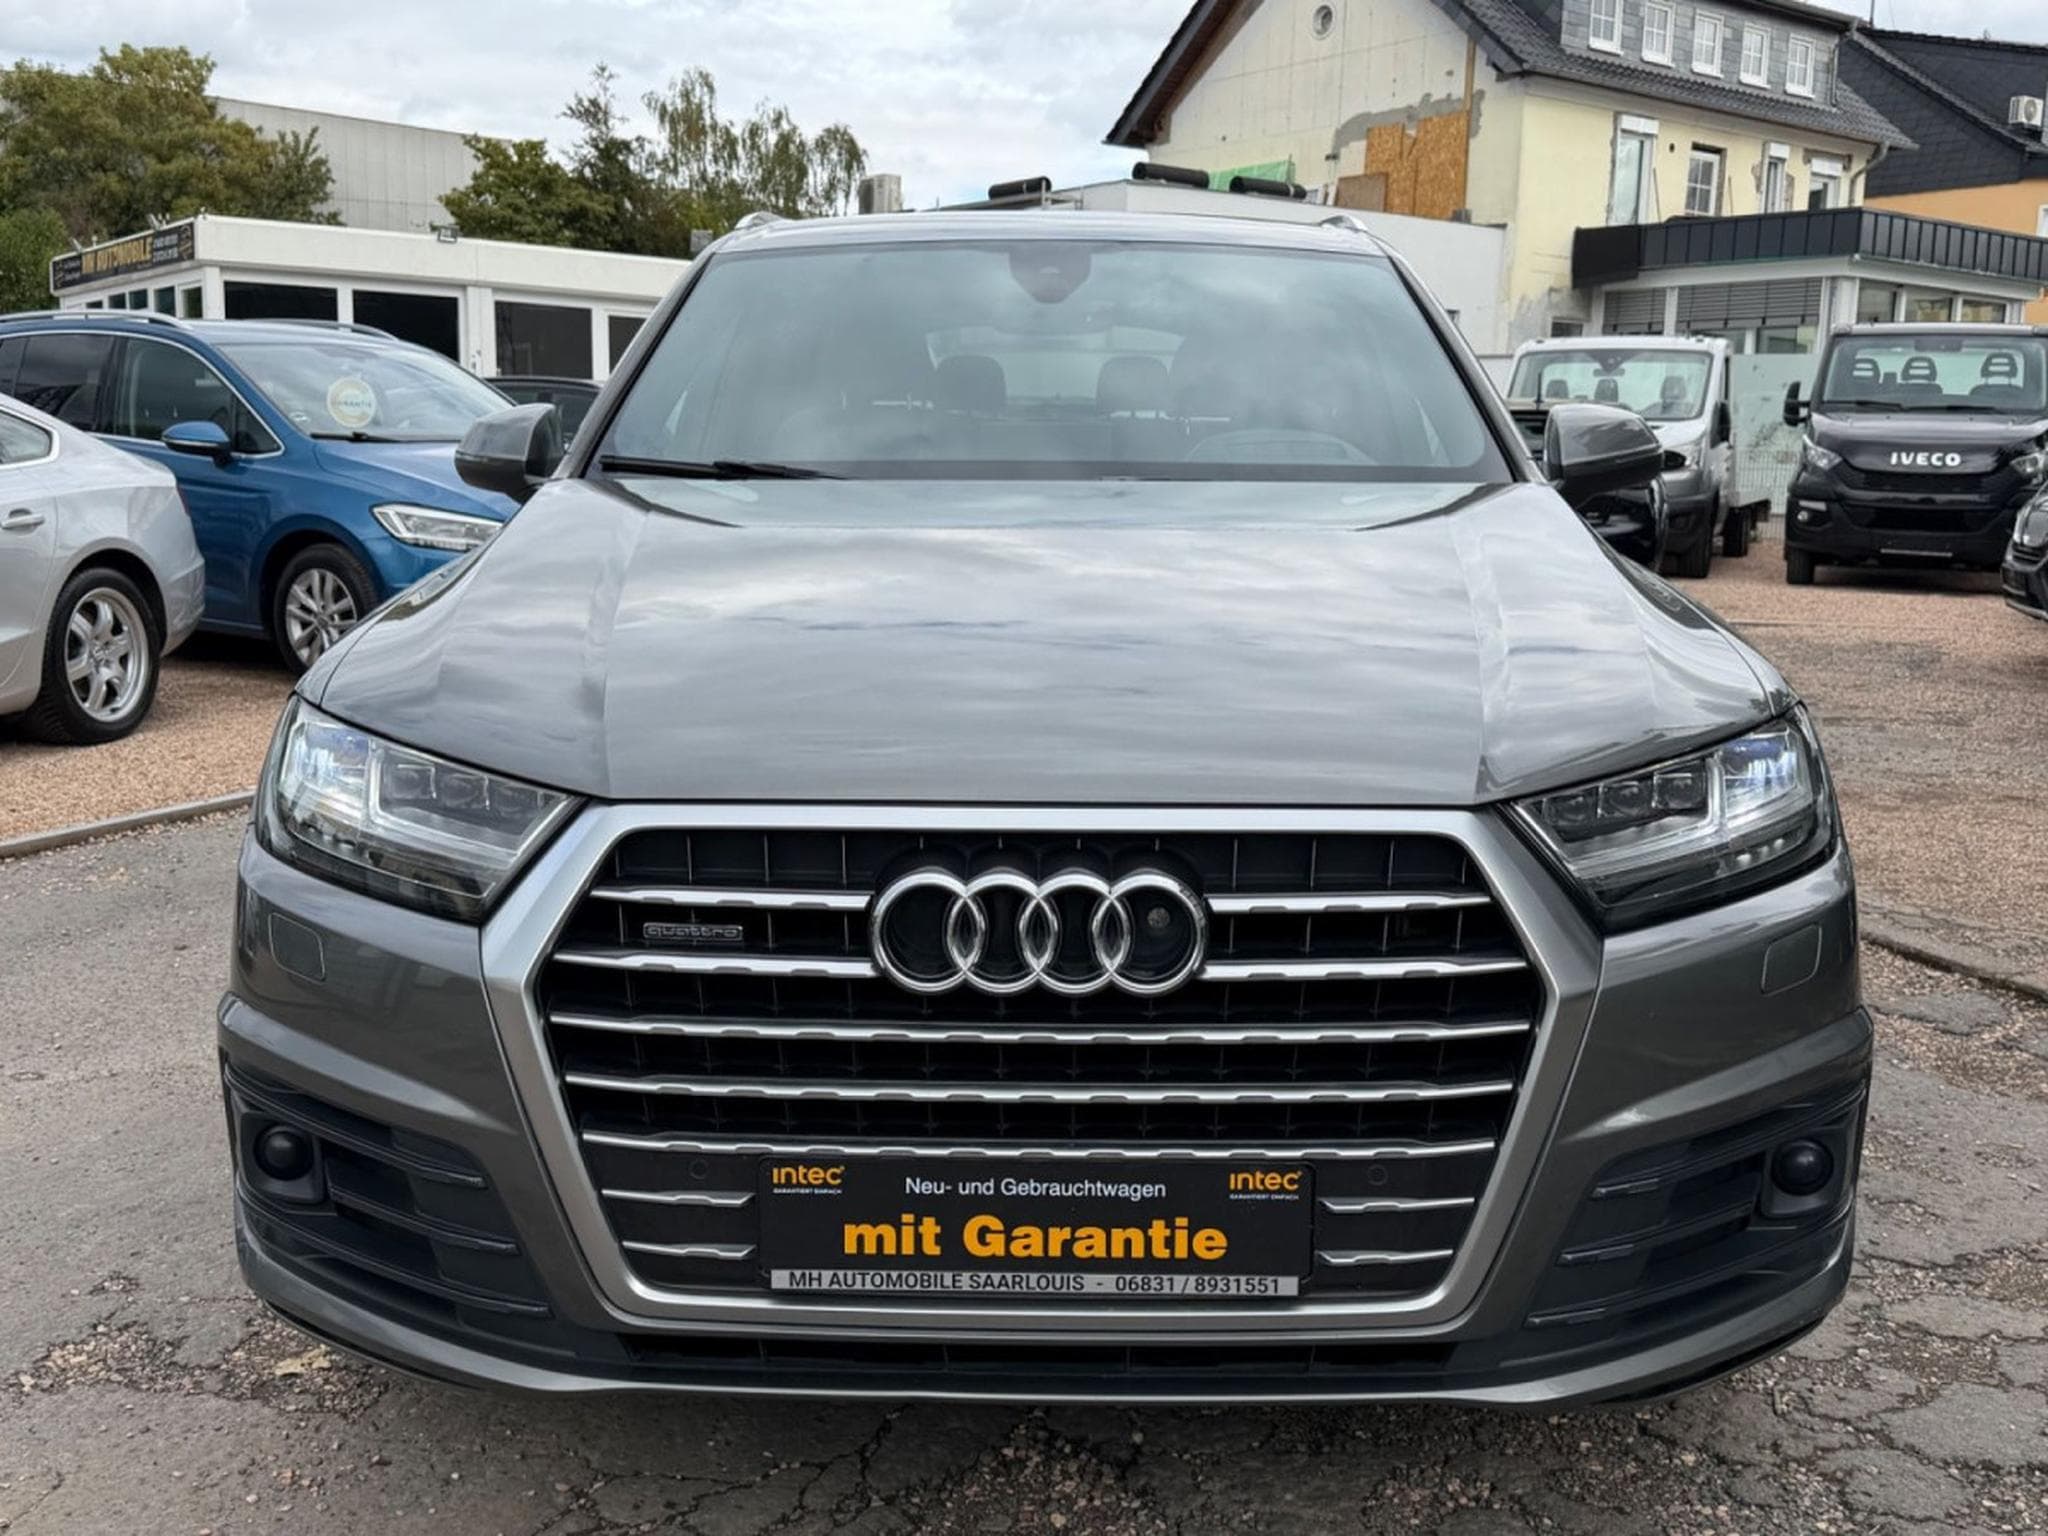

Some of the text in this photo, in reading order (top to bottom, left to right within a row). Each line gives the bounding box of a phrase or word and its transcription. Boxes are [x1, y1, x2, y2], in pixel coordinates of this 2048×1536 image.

[1890, 452, 1961, 467] IVECO
[647, 927, 738, 938] quattro
[772, 1165, 844, 1185] intec
[1229, 1170, 1300, 1190] intec
[905, 1177, 1166, 1202] Neu- und Gebrauchtwagen
[844, 1213, 1228, 1260] mit Garantie
[789, 1271, 822, 1288] MH
[828, 1271, 963, 1290] AUTOMOBILE
[968, 1273, 1085, 1291] SAARLOUIS
[1115, 1276, 1175, 1292] 06831
[1194, 1276, 1279, 1294] 8931551
